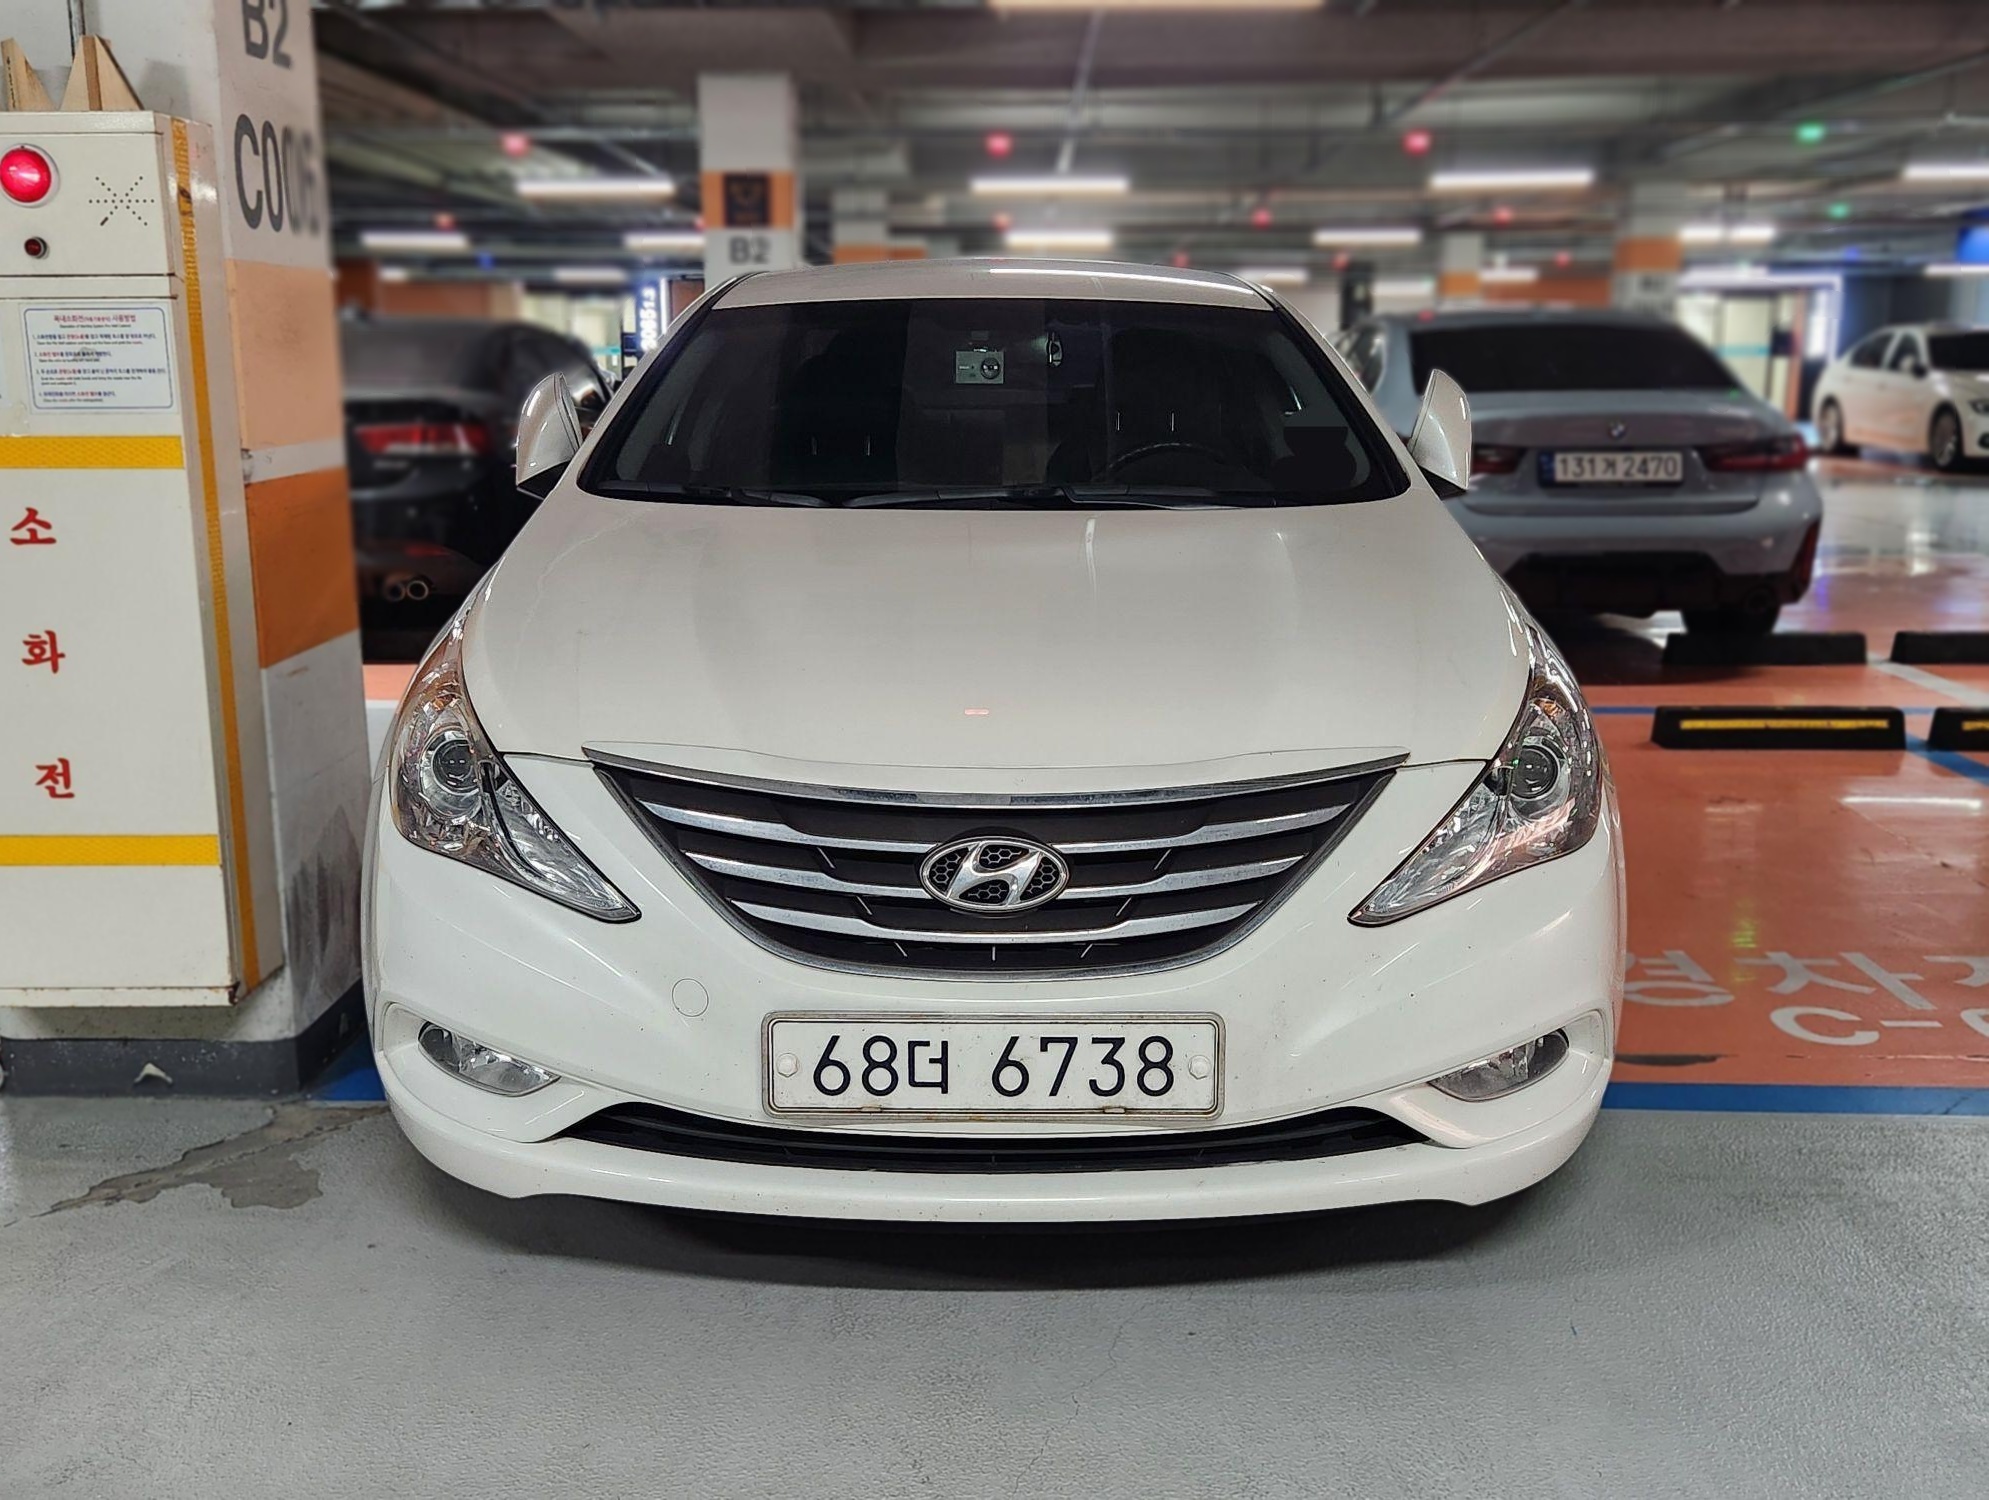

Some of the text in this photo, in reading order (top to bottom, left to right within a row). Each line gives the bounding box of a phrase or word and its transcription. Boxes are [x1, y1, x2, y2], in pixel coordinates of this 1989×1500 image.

[241, 0, 292, 69] B2
[729, 236, 770, 265] B2
[1623, 456, 1677, 477] 2470
[10, 507, 75, 799] 소화전
[1769, 1006, 1989, 1046] C-
[813, 1035, 1175, 1097] 68더 6738
